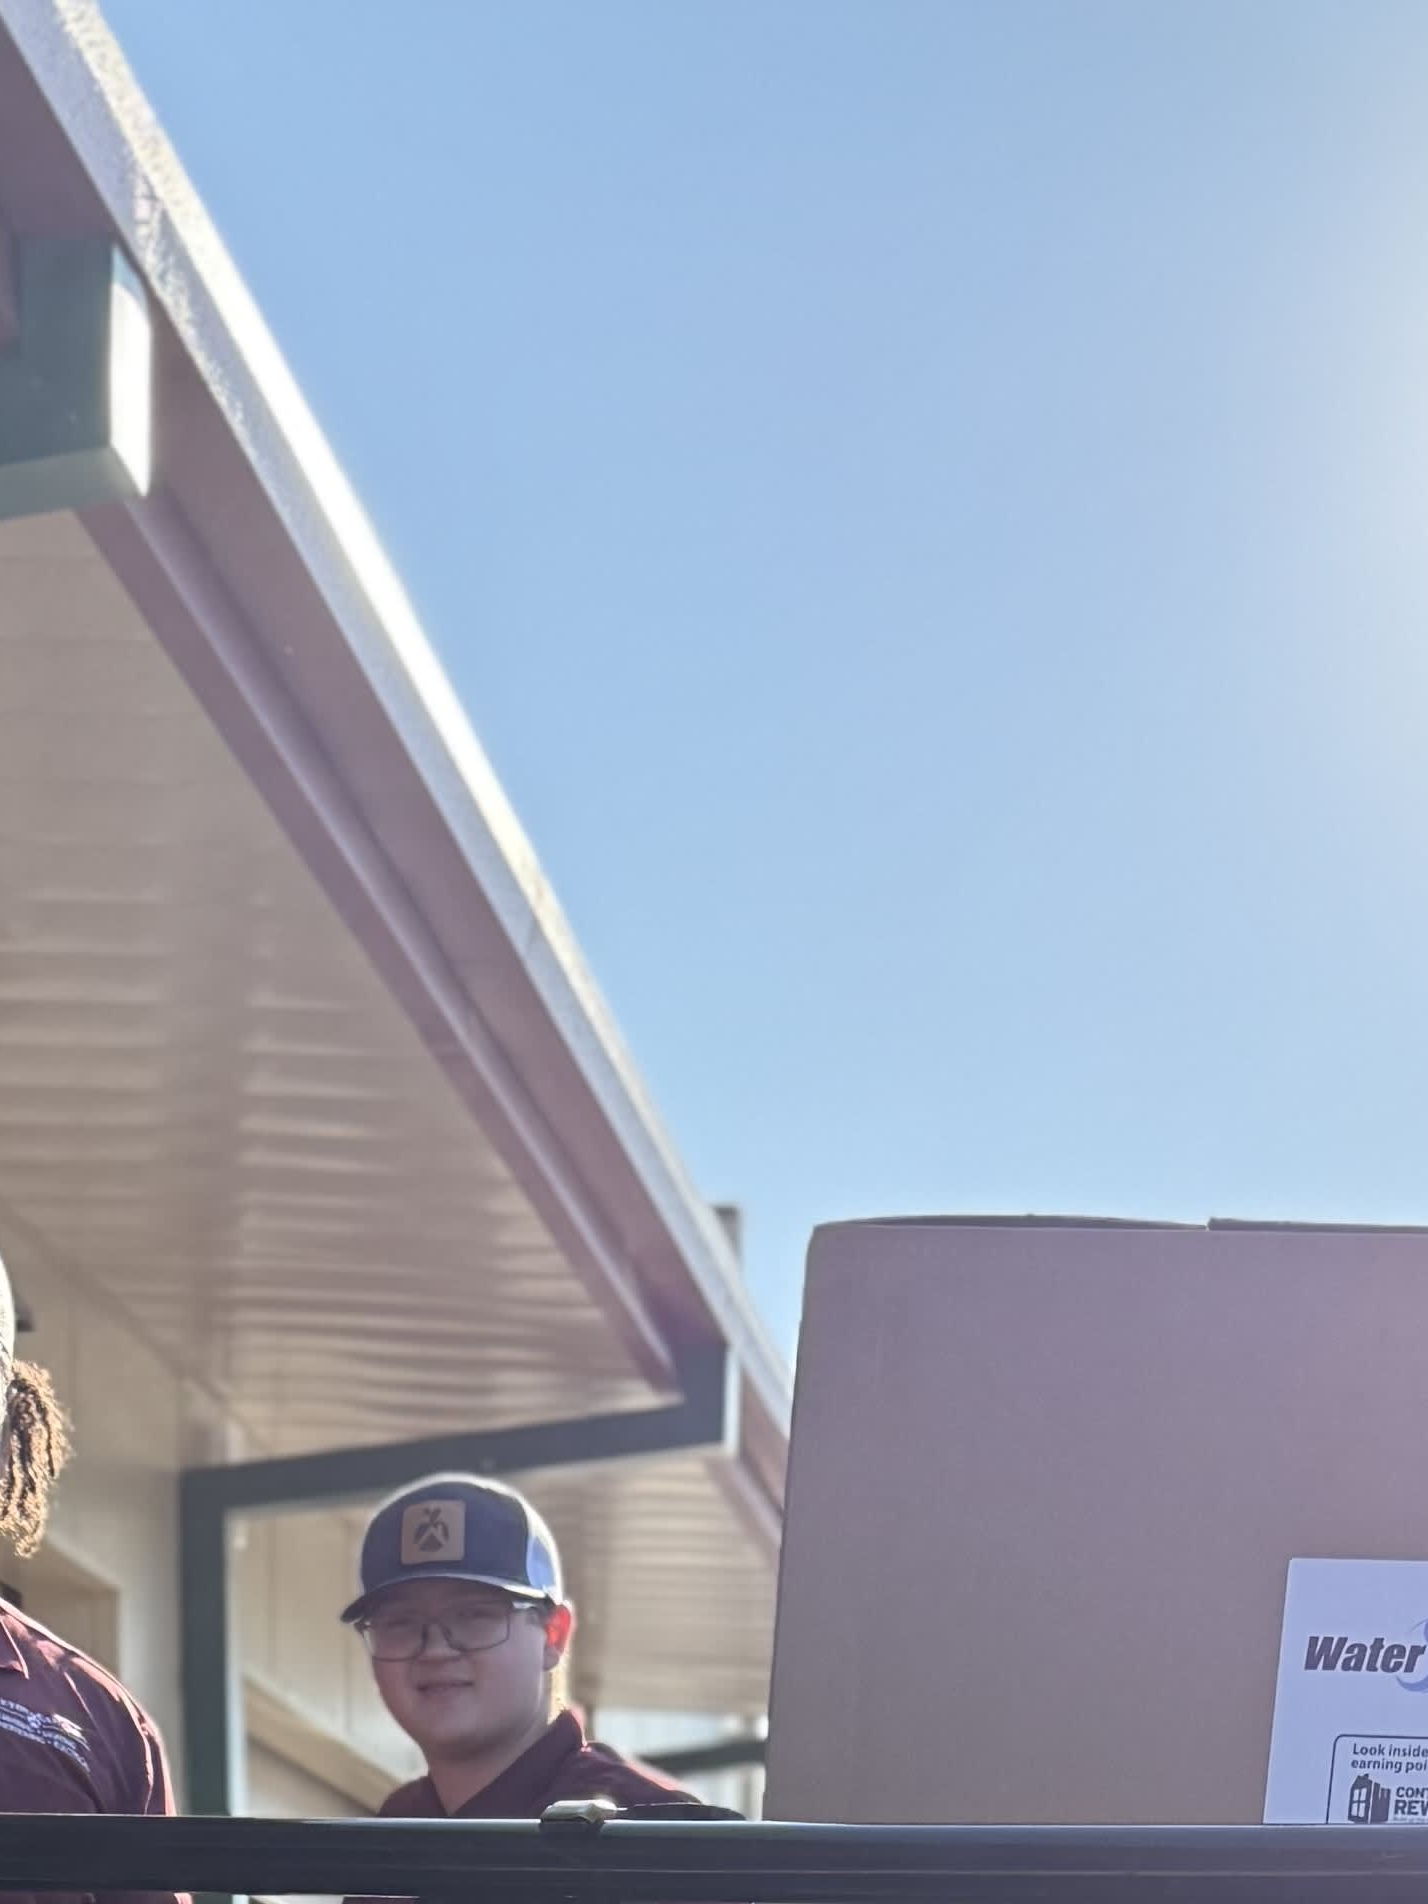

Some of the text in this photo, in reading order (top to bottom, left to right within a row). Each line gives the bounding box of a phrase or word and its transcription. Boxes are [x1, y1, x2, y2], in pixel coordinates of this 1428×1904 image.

[1304, 1636, 1427, 1673] Water
[1353, 1743, 1385, 1756] Look
[1388, 1744, 1428, 1758] inside
[1351, 1758, 1403, 1773] earning
